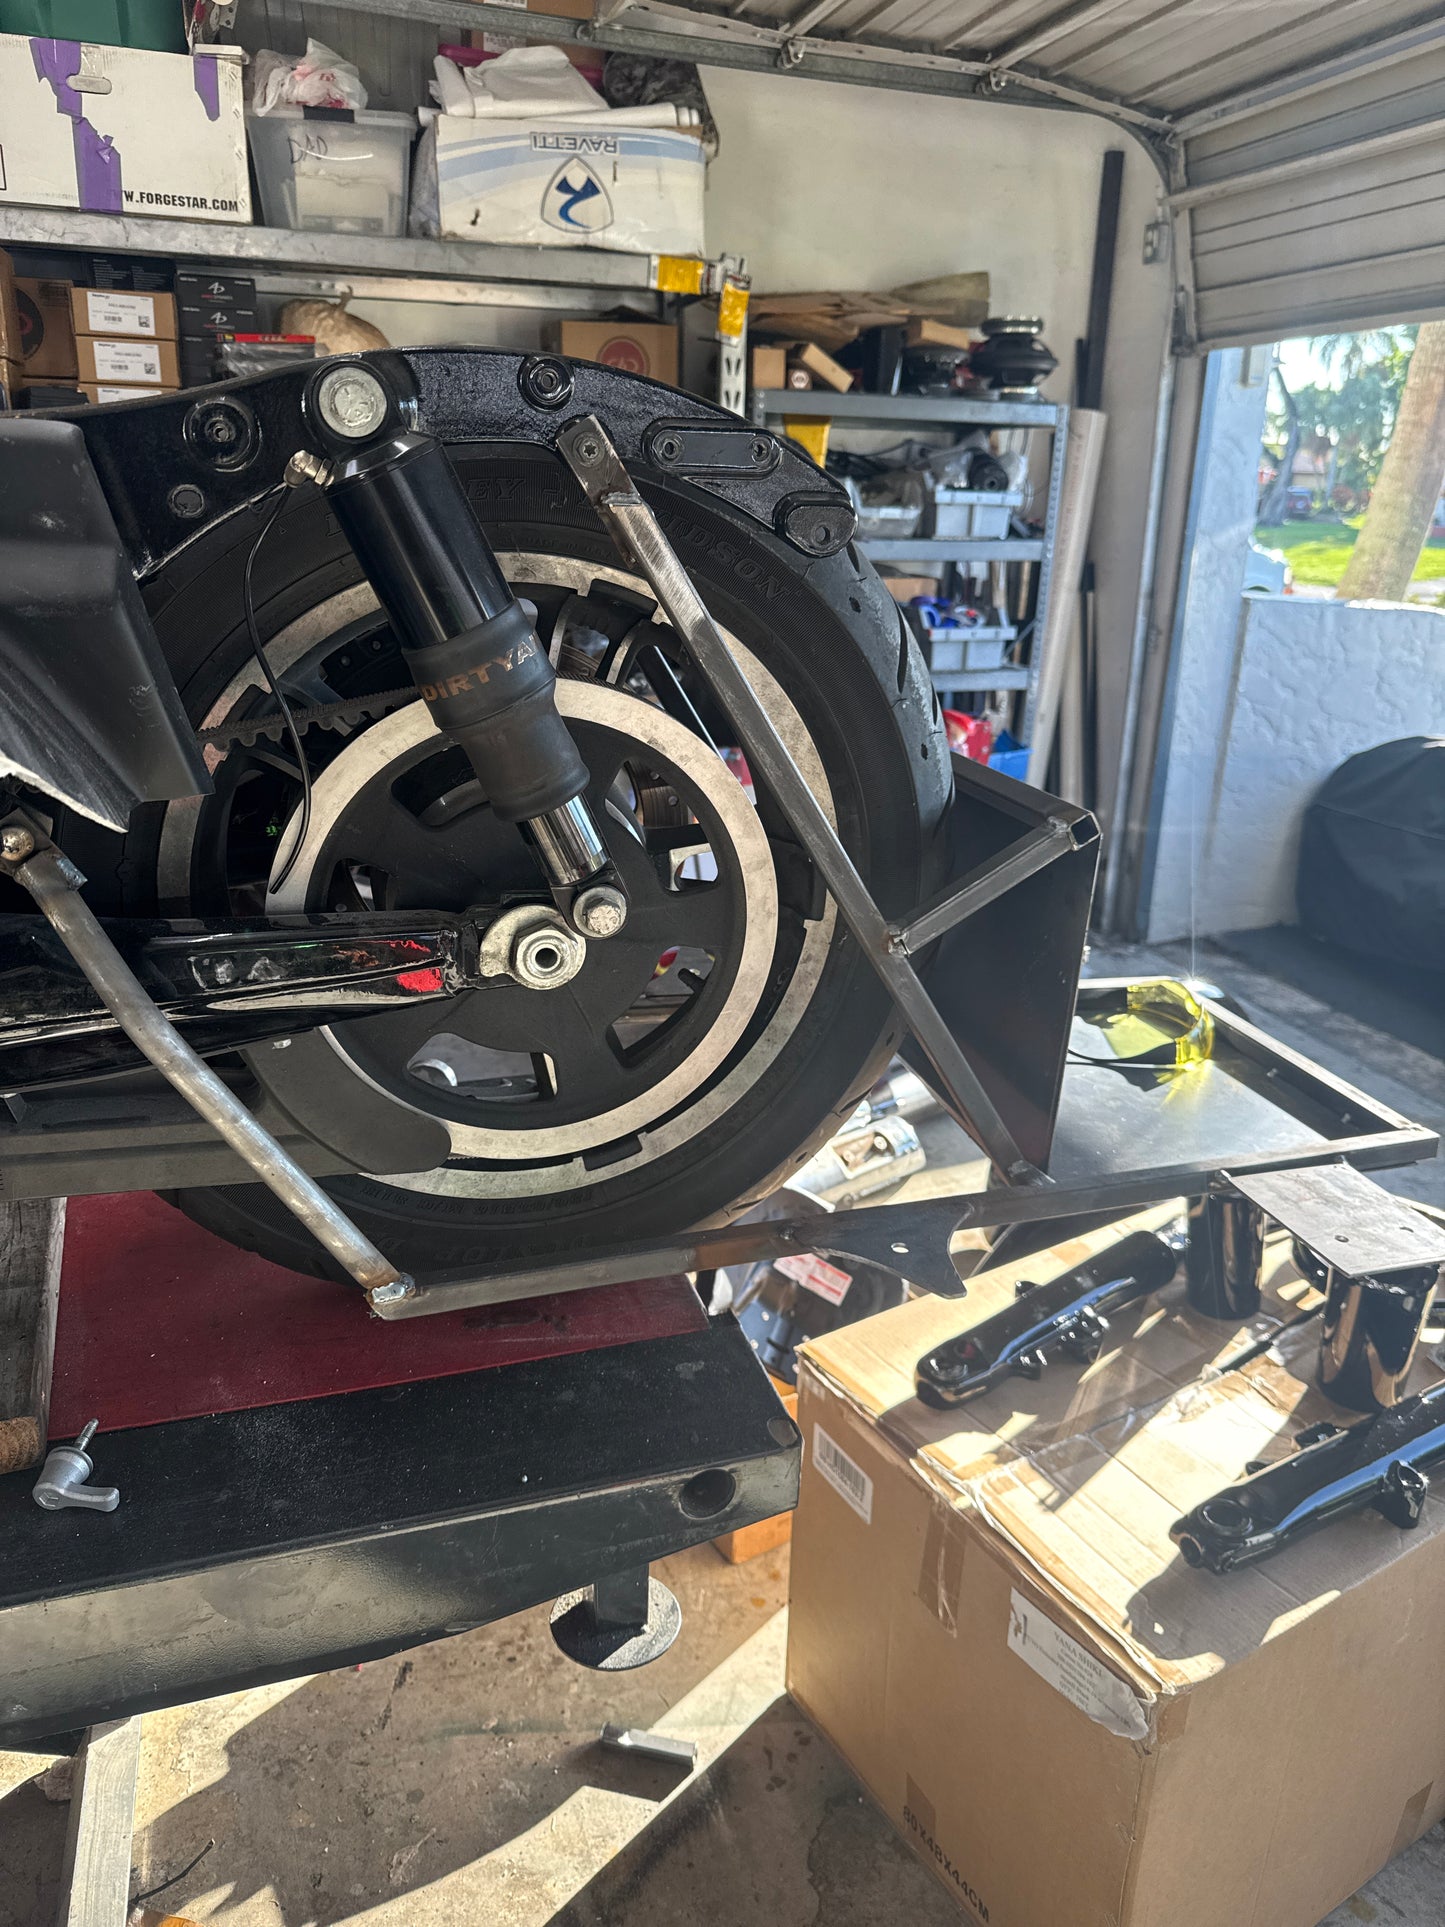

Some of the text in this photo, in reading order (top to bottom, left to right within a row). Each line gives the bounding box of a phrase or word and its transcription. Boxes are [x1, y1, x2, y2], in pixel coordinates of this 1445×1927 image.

[288, 134, 328, 164] DAD
[532, 135, 617, 153] RAVETTI
[122, 190, 239, 213] W.FORGESTAR.COM
[421, 634, 537, 701] DIRTYA
